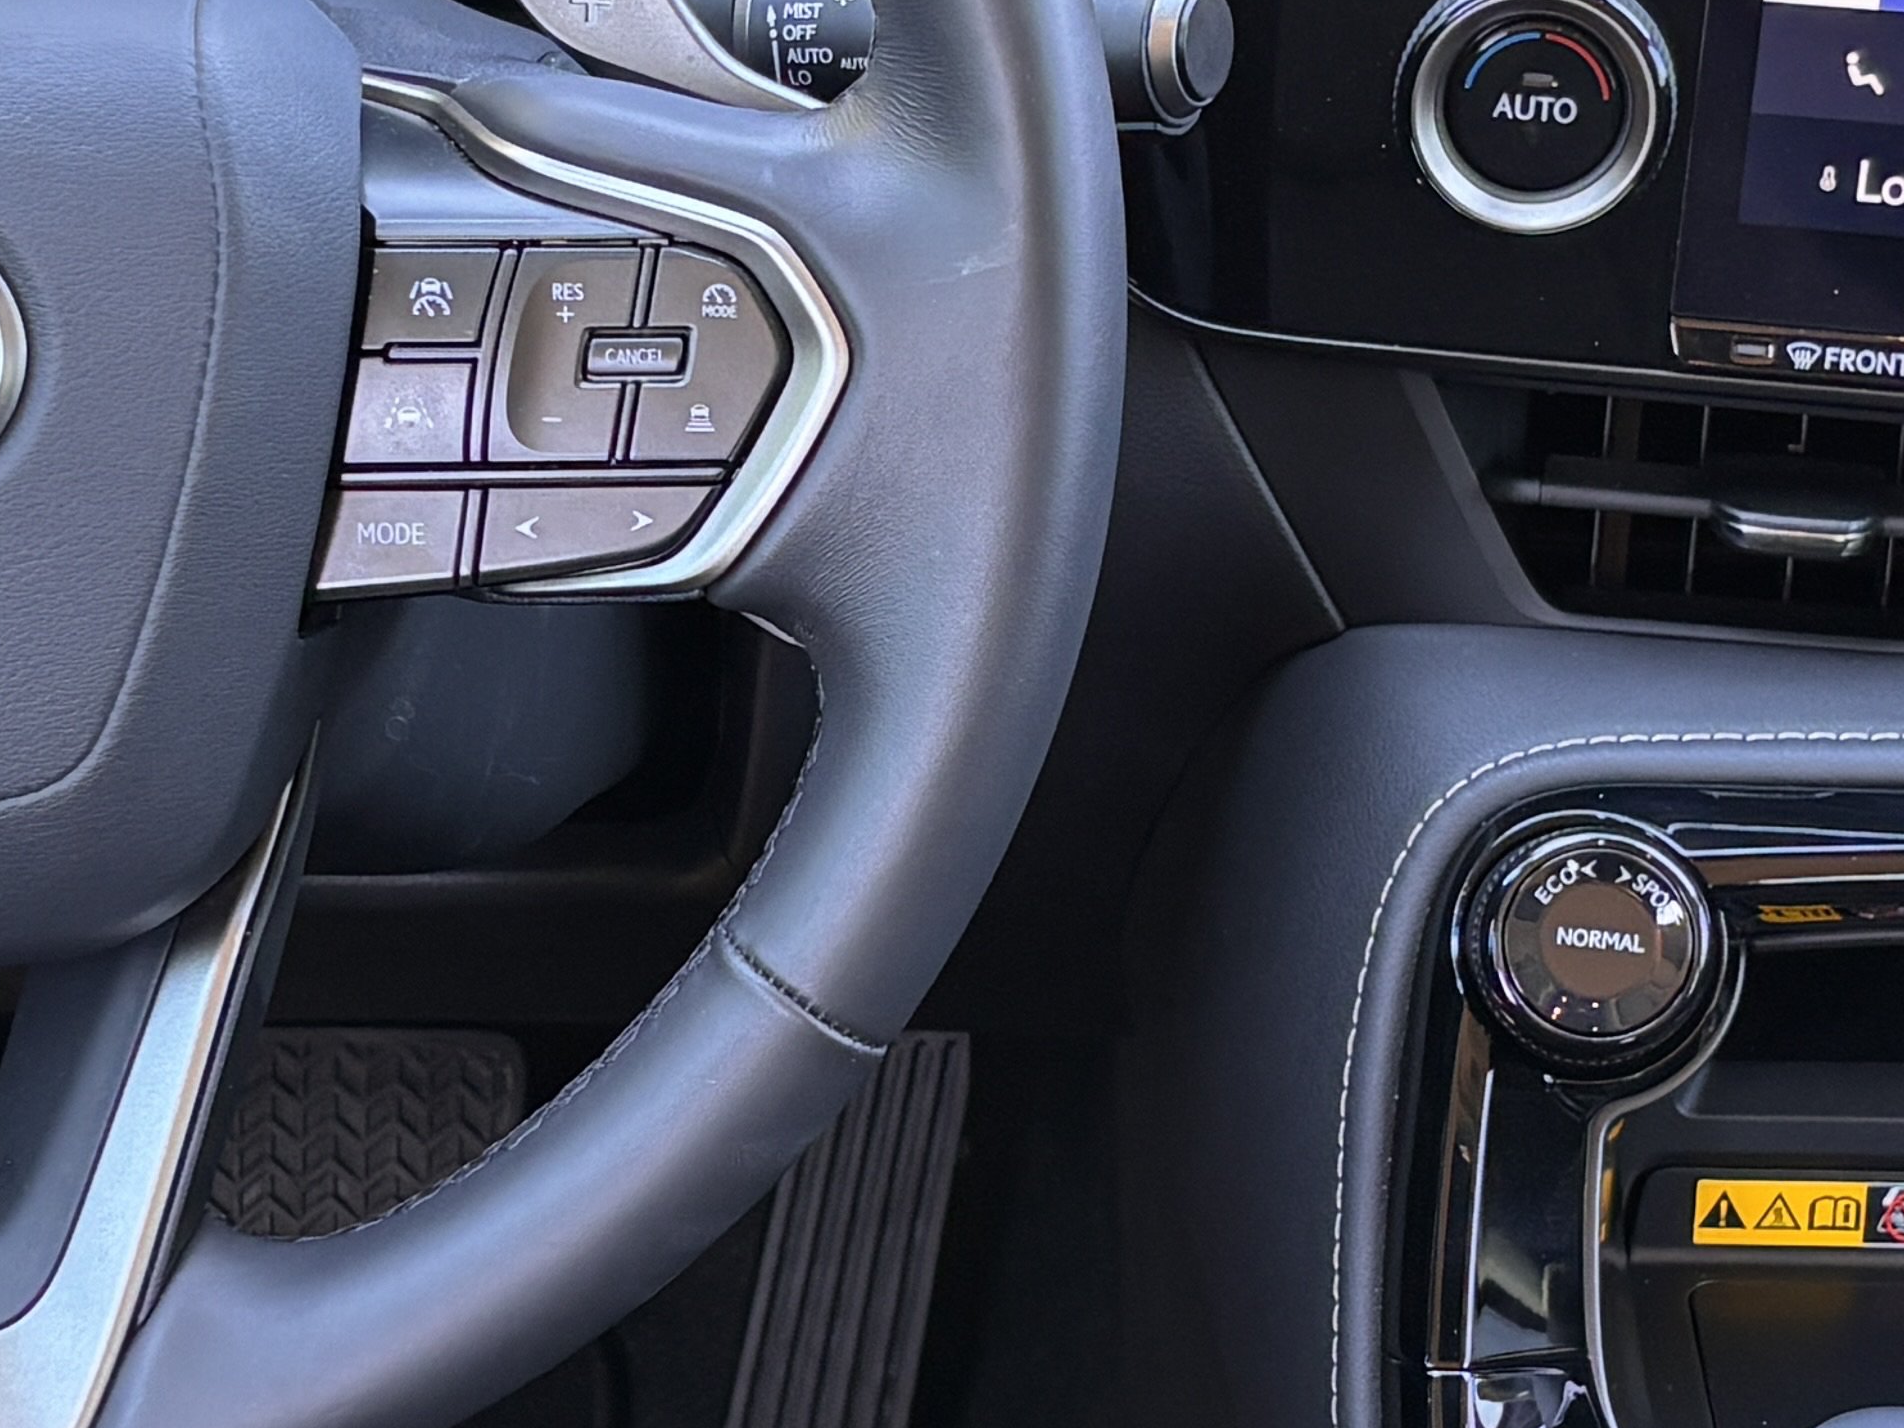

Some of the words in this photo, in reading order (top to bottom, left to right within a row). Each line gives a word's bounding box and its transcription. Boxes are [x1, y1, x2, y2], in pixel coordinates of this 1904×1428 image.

[782, 2, 824, 19] MIST
[782, 24, 817, 41] OFF
[787, 47, 833, 64] AUTO
[788, 70, 812, 86] LO
[1493, 92, 1578, 124] AUTO
[552, 283, 584, 301] RES
[702, 305, 738, 319] MODE
[605, 348, 665, 364] CANCEL
[357, 522, 426, 545] MODE
[1534, 865, 1579, 905] ECO
[1632, 873, 1684, 926] SPO
[1556, 926, 1645, 954] NORMAL
